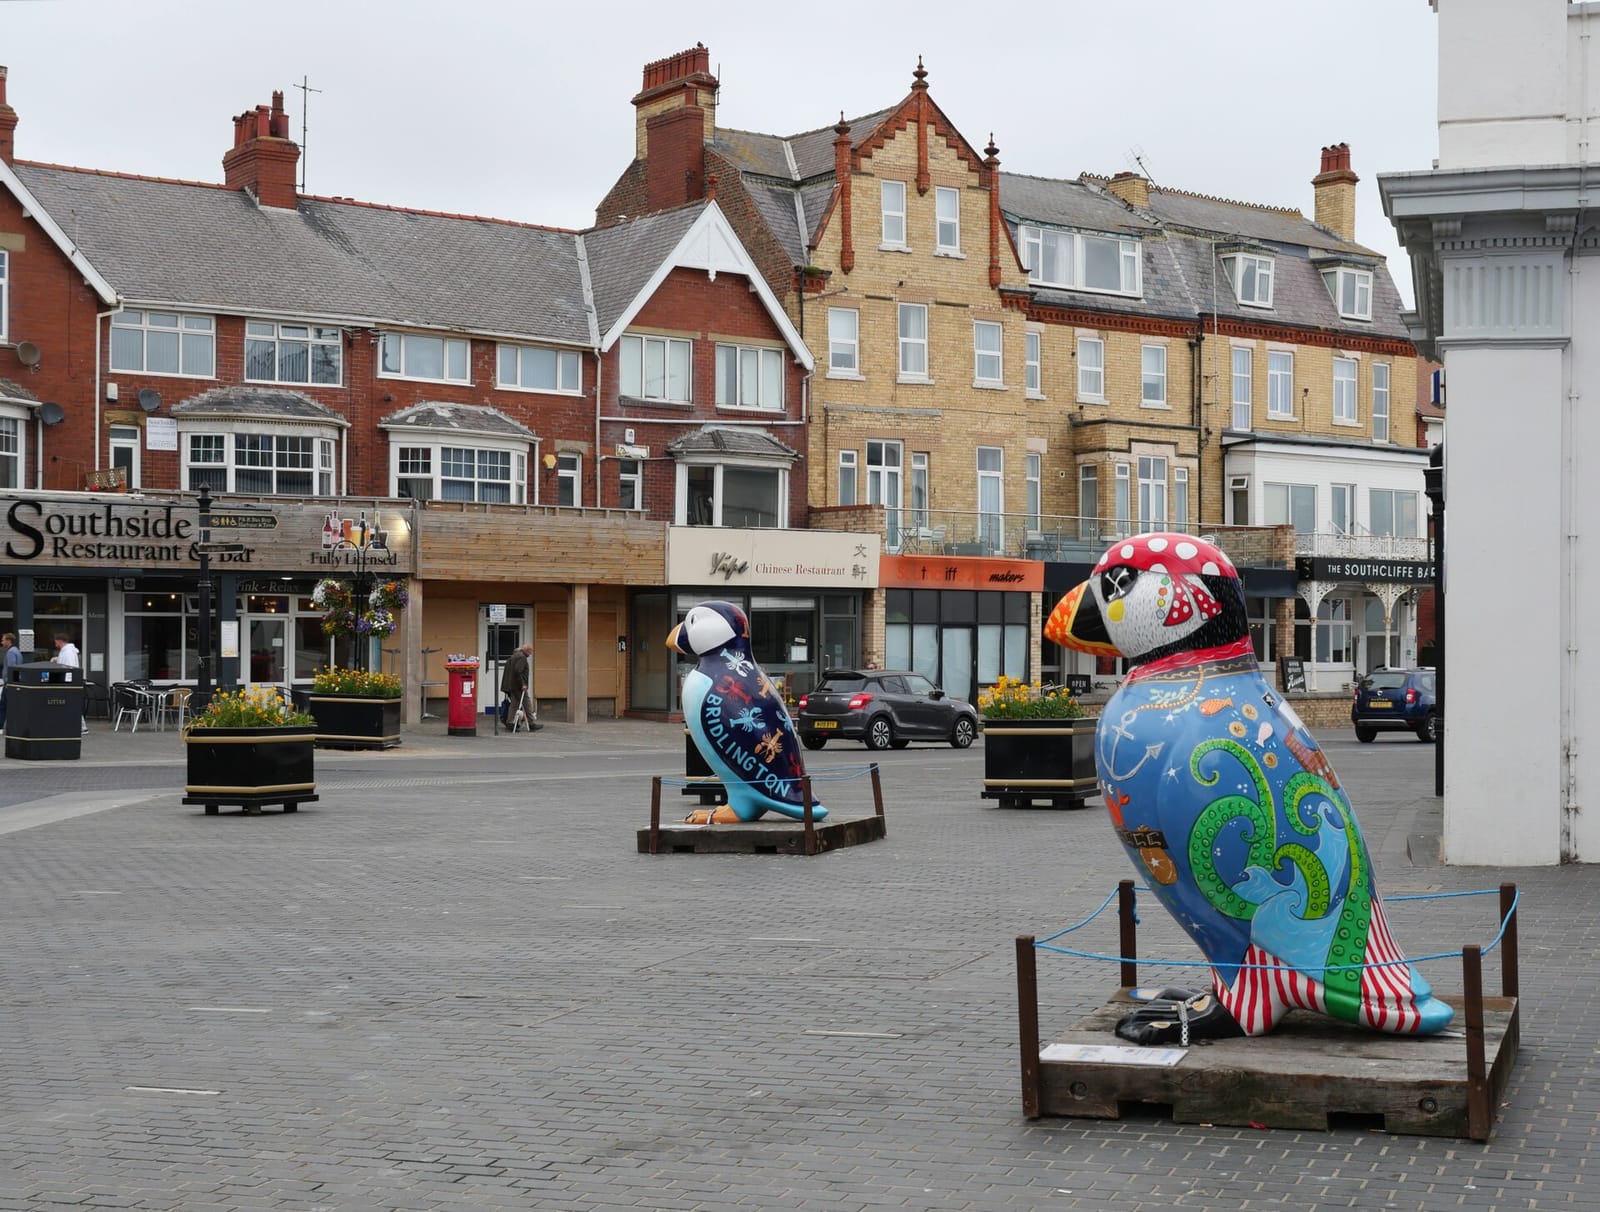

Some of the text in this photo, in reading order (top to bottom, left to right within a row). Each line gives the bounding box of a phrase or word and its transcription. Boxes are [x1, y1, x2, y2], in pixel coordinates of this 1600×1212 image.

[5, 500, 192, 560] Southside
[52, 536, 182, 561] Restaurant
[755, 562, 792, 574] Chinese
[796, 563, 845, 576] Restaurant
[989, 570, 1024, 583] makers
[1328, 565, 1340, 574] THE
[1344, 564, 1413, 578] SOUTHCLIFFE
[706, 694, 790, 798] BRIDLINGTON
